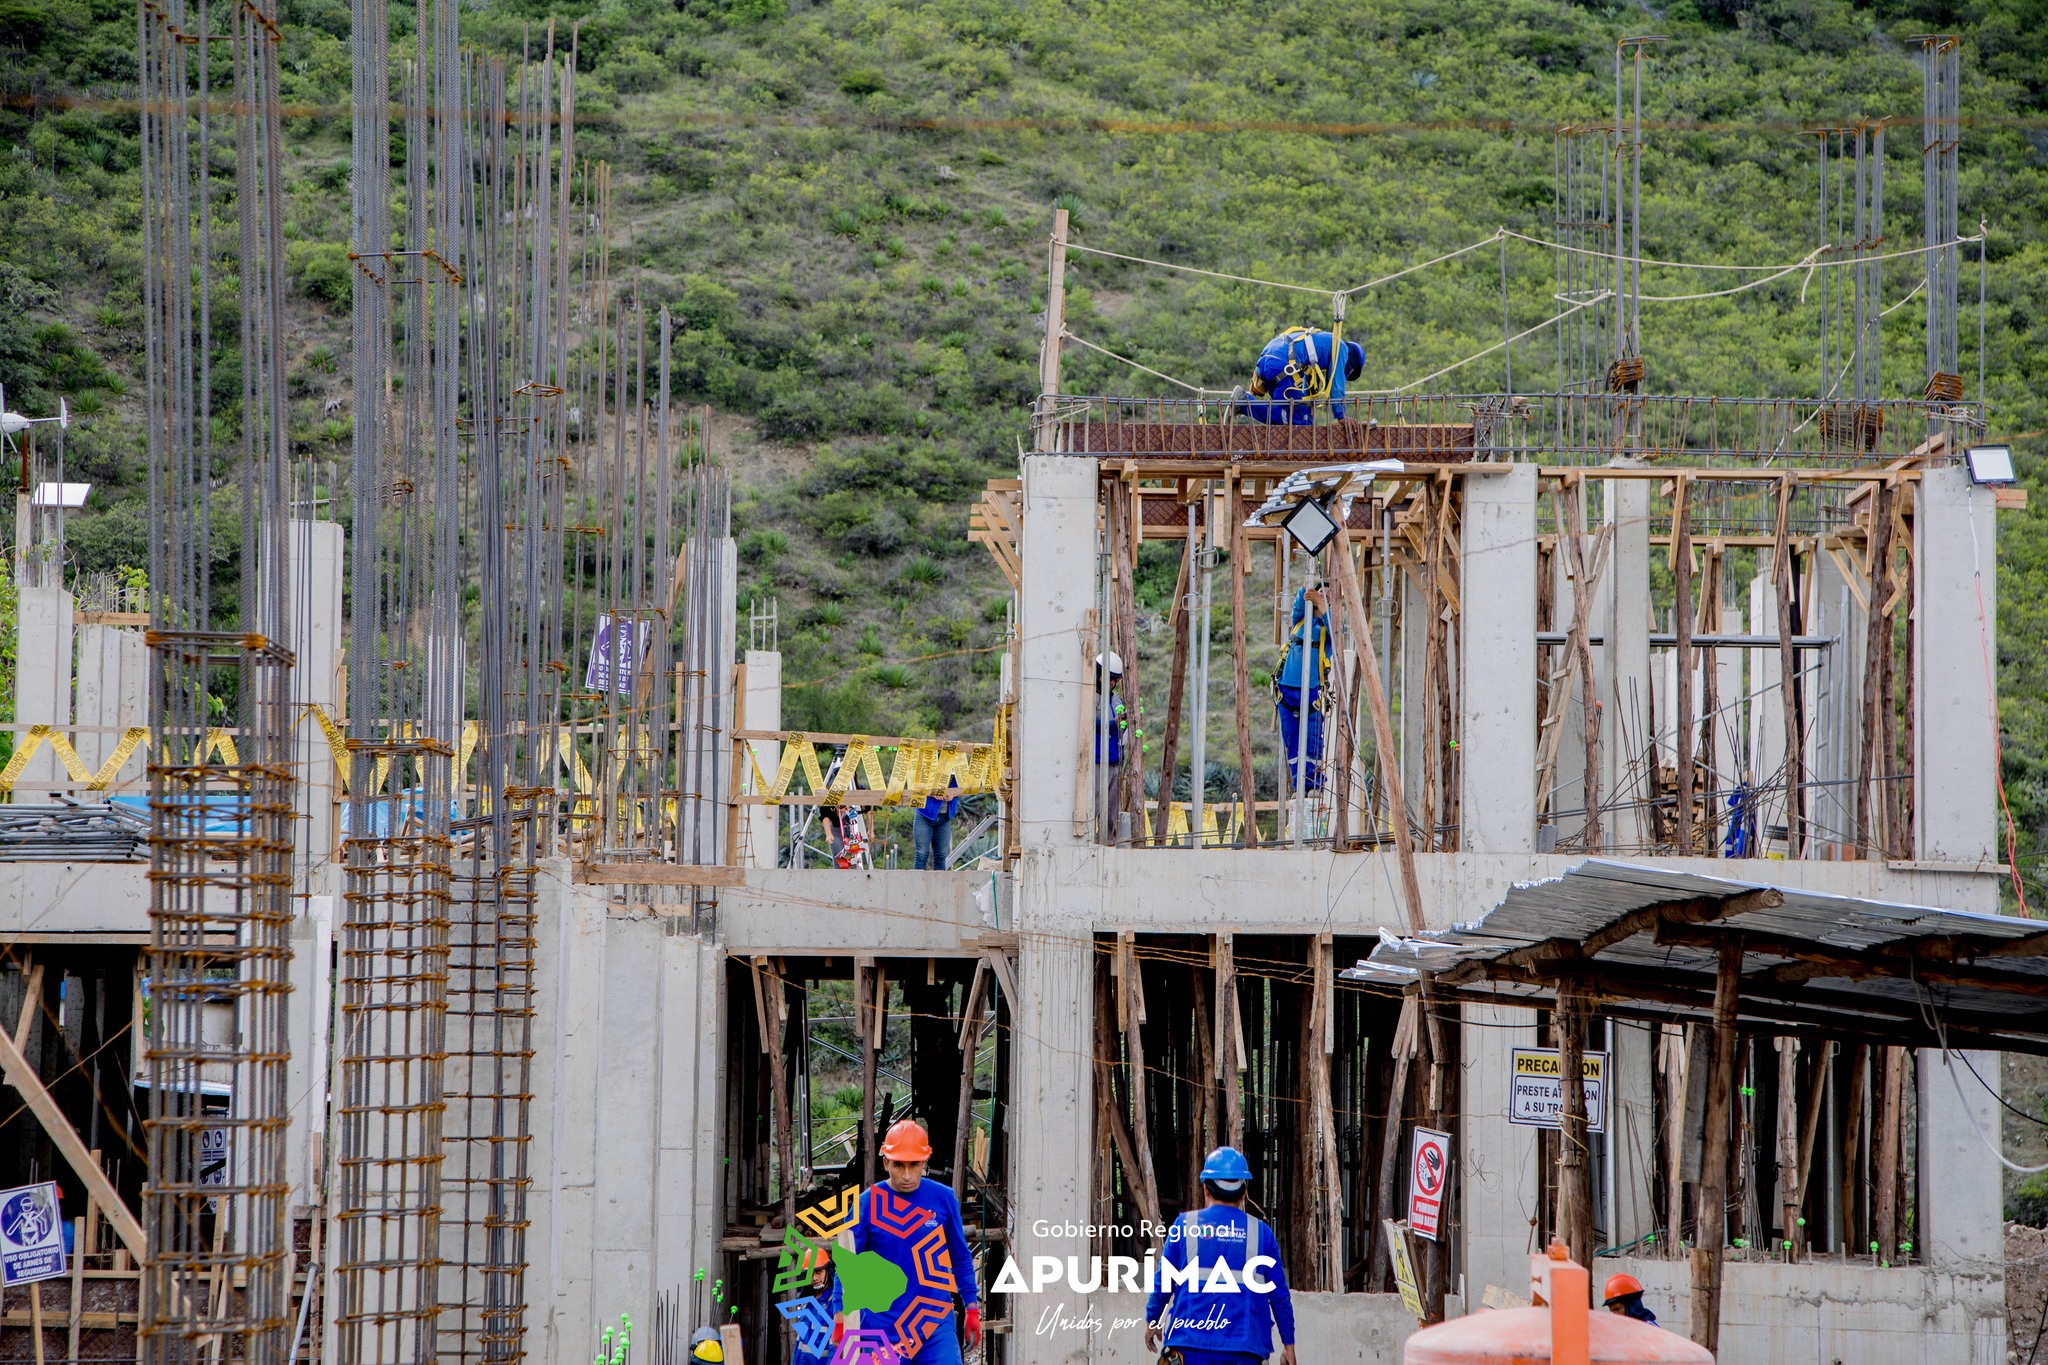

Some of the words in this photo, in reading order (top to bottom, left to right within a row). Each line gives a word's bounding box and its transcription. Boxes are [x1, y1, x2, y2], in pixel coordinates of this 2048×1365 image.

[125, 728, 145, 753] OBRAS
[326, 731, 340, 758] OBRAS
[857, 739, 865, 750] NO
[846, 751, 861, 773] PASAR
[892, 750, 904, 778] OBRAS
[898, 749, 912, 782] PELIGRO
[923, 750, 932, 761] NO
[969, 748, 979, 775] OBRAS
[974, 746, 987, 779] PELIGRO
[0, 752, 24, 783] PELIGRO
[8, 758, 28, 784] OBRAS
[94, 762, 113, 784] PASAR
[782, 768, 792, 781] NO
[921, 761, 931, 784] PASAR
[940, 774, 949, 784] NO
[1517, 1058, 1600, 1076] PRECAÓN
[1517, 1085, 1550, 1098] PRESTE
[1525, 1101, 1530, 1111] A
[1533, 1102, 1544, 1113] SU
[19, 1247, 58, 1260] OBLIGATORIO
[13, 1262, 22, 1270] DE
[16, 1265, 51, 1278] SEGURIDAD
